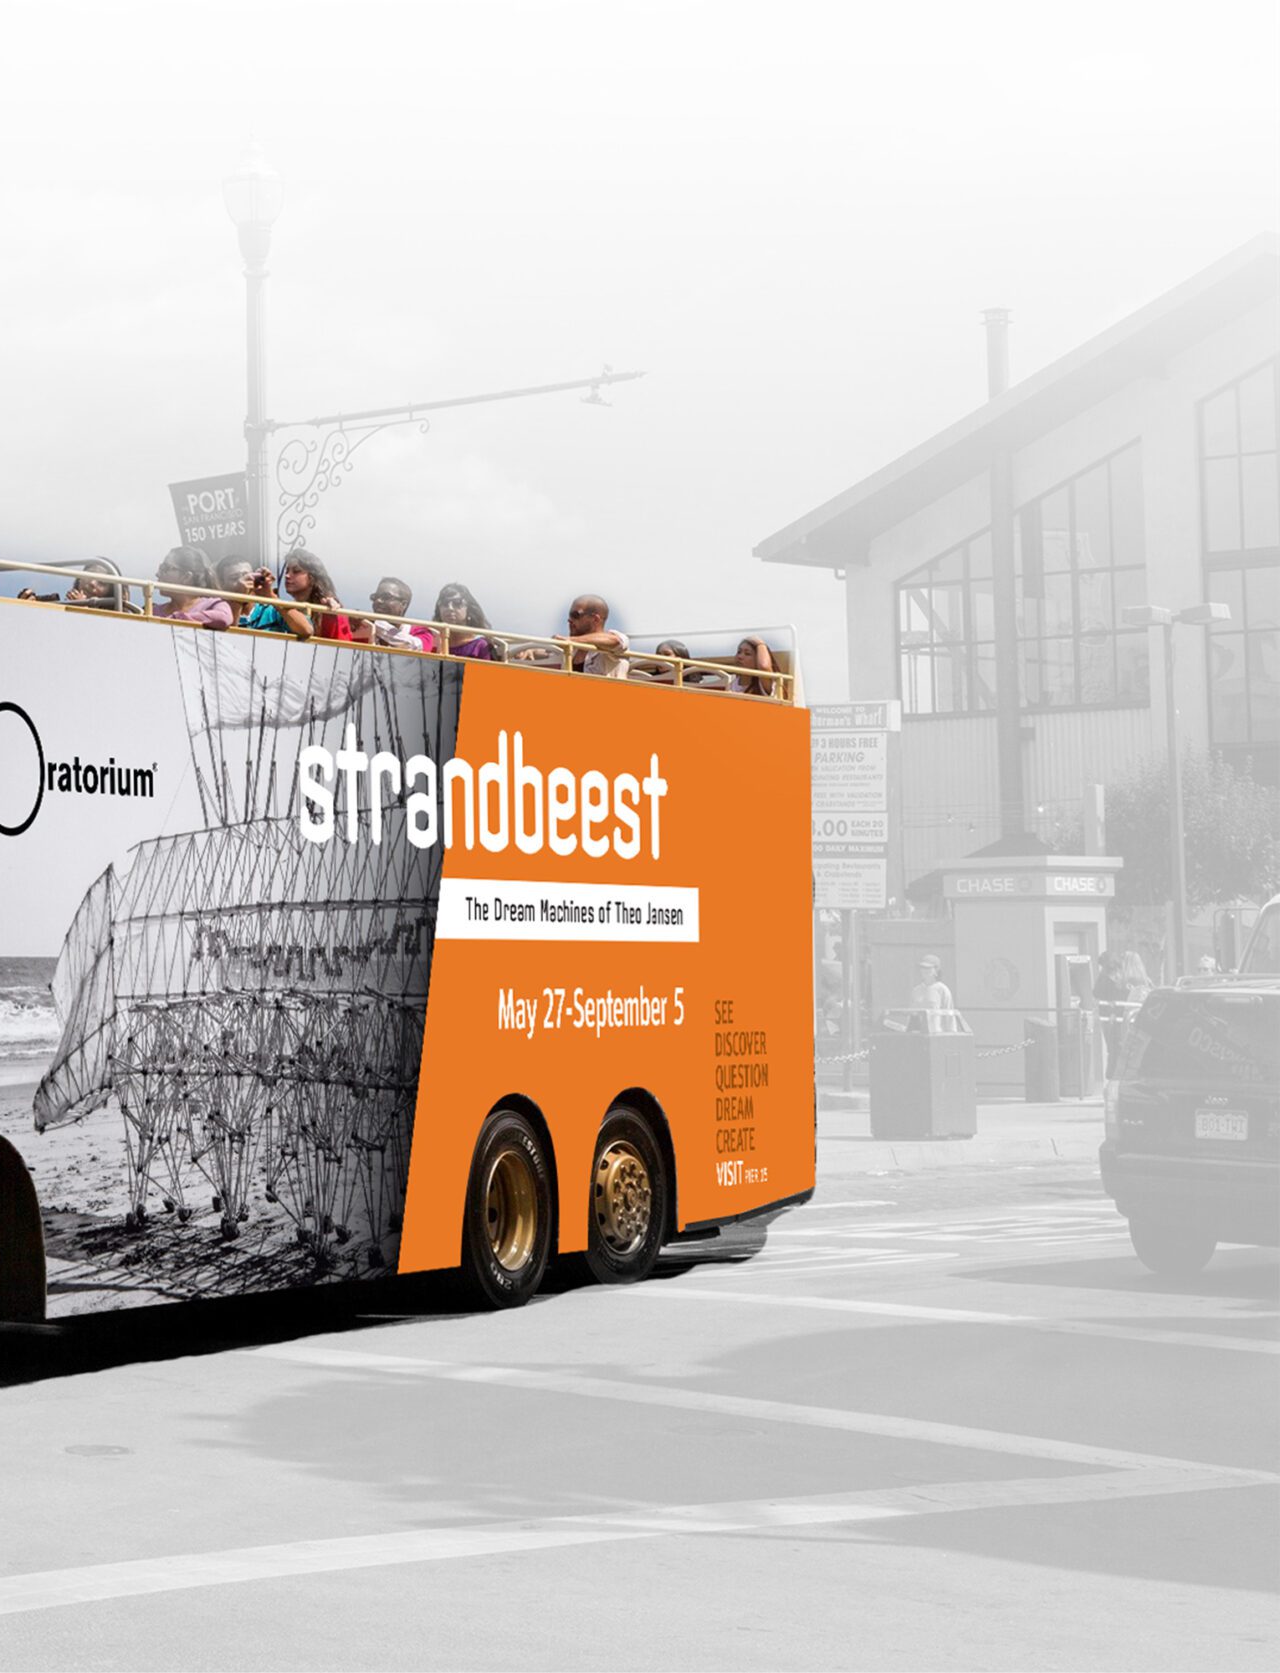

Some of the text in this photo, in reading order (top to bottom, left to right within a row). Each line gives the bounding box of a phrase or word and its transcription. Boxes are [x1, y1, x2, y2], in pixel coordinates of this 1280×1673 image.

[186, 487, 235, 515] PORT
[185, 520, 246, 543] 150 YEARS
[828, 737, 857, 749] HOURS
[858, 737, 879, 748] FREE
[814, 751, 865, 763] PARKING
[298, 722, 669, 861] strandbeest
[851, 820, 871, 828] EACH
[872, 820, 884, 828] 20
[956, 877, 1015, 892] CHASE
[1053, 876, 1096, 892] CHASE
[465, 896, 684, 926] The Dream Machines of Theo Jansen
[498, 985, 685, 1040] May 27-September 5
[714, 999, 734, 1025] SEE
[714, 1030, 767, 1057] DISCOVER
[715, 1063, 769, 1093] QUESTION
[715, 1096, 754, 1122] DREAM
[716, 1127, 756, 1154] CREATE
[715, 1160, 744, 1186] VISIT
